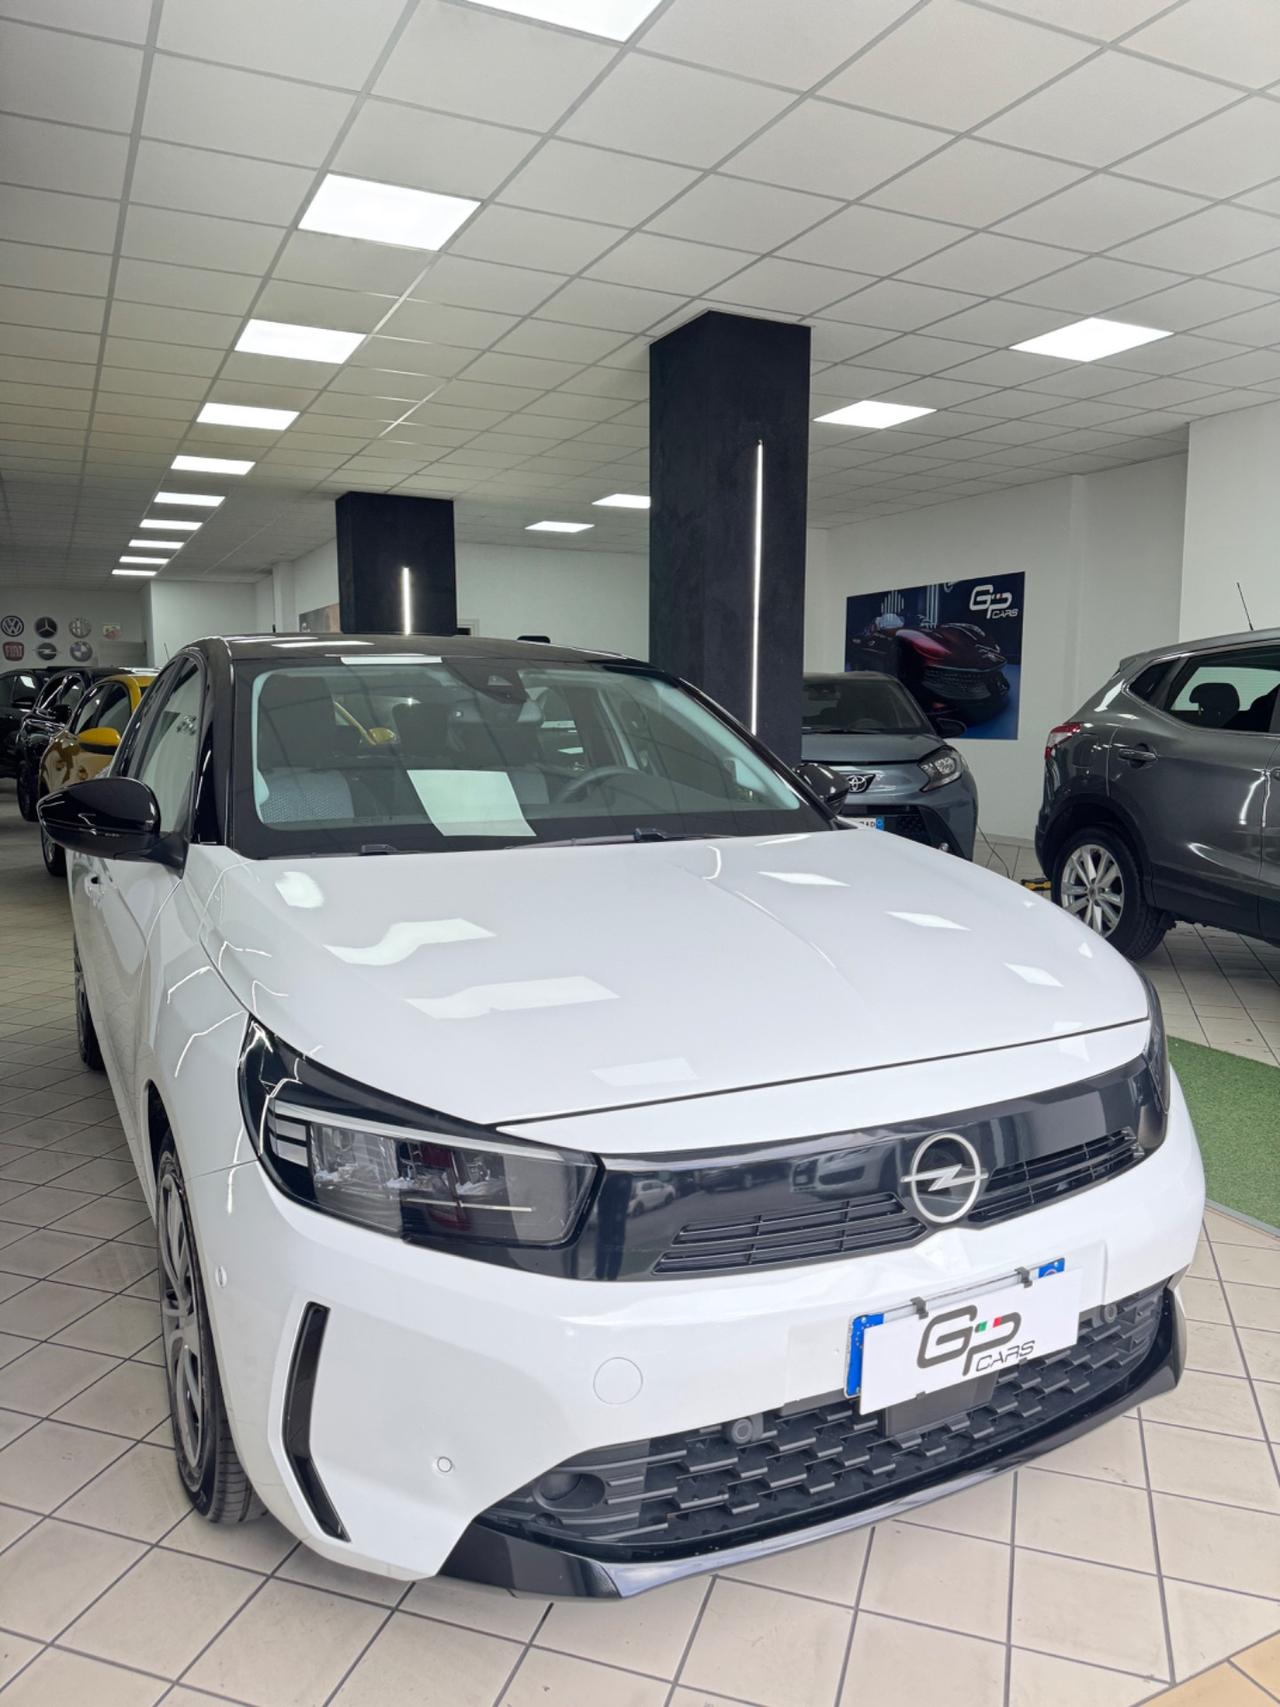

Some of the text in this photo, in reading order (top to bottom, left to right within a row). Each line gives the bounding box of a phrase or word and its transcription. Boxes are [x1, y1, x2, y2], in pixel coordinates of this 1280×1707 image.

[969, 584, 1012, 619] GP
[992, 609, 1018, 619] CARS
[3, 617, 23, 636] VW
[917, 1305, 1021, 1376] GP
[976, 1340, 1035, 1371] CARS
